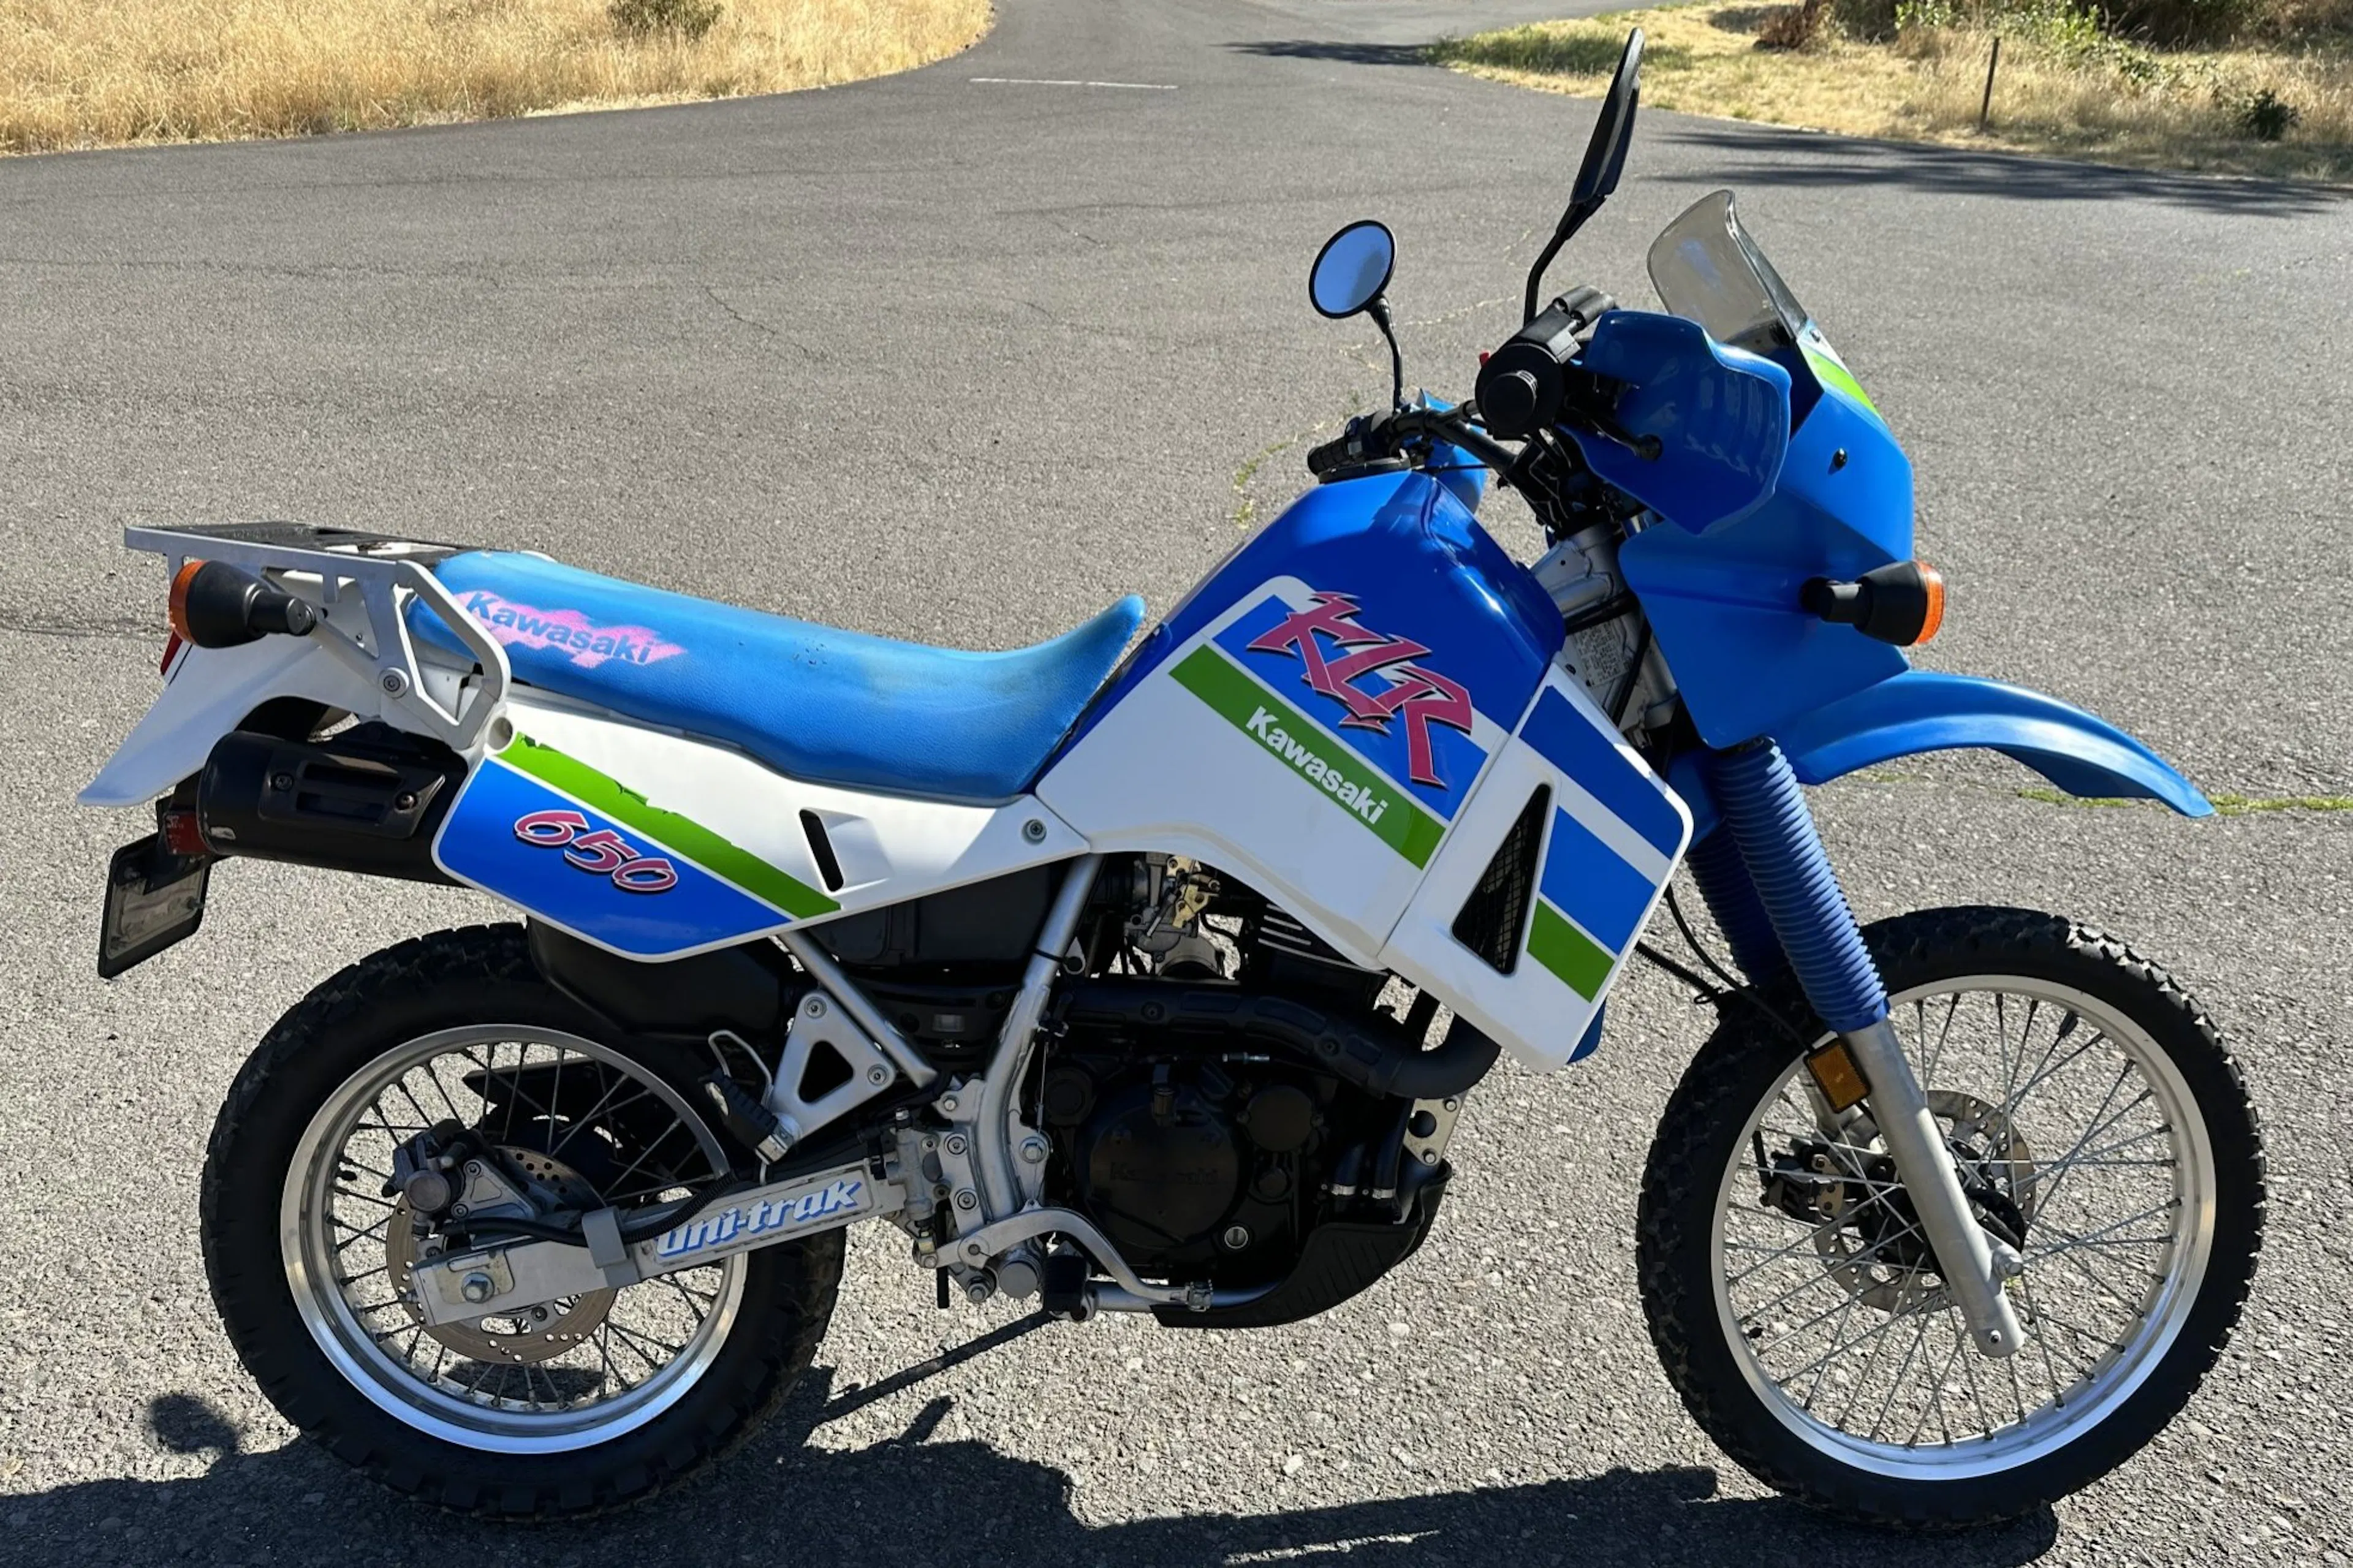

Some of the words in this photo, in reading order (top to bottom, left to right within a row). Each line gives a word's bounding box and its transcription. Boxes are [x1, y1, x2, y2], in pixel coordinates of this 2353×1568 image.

[466, 592, 653, 665] Kawasaki
[1246, 591, 1472, 790] KLR
[1246, 705, 1389, 824] Kawasaki
[513, 809, 678, 895] 650
[654, 1180, 861, 1256] uni-trak
